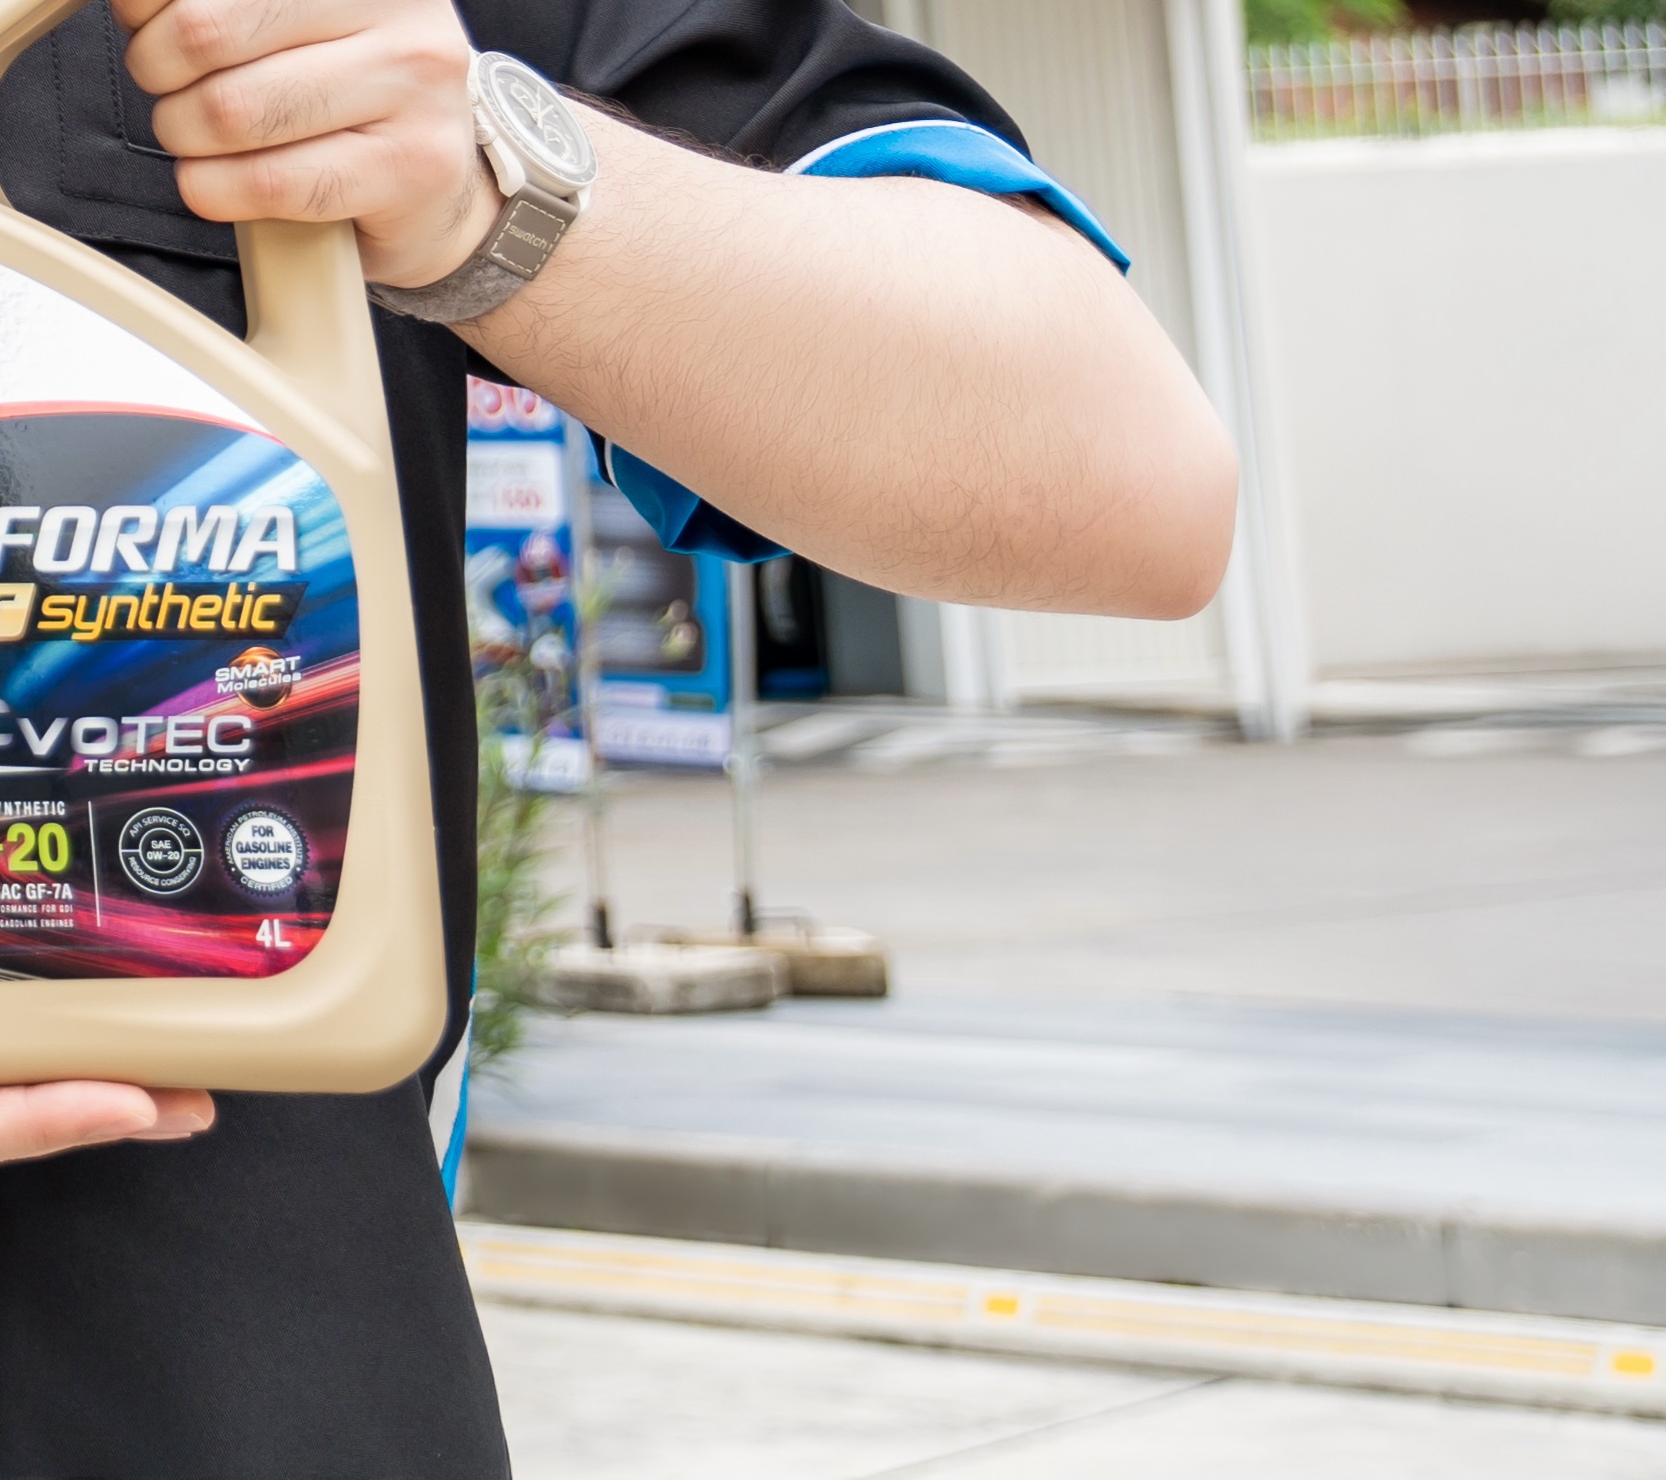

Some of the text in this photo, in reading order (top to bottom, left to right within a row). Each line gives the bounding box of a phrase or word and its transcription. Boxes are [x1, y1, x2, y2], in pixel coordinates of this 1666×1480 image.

[508, 225, 548, 250] swatch
[38, 582, 283, 641] synthetic
[215, 656, 301, 682] SMART
[217, 671, 302, 694] Molecules
[84, 758, 251, 774] TECHNOLOGY
[129, 823, 143, 837] API
[142, 815, 178, 827] SERVICE
[238, 811, 287, 826] PETROLEUM
[251, 826, 274, 837] FOR
[151, 840, 172, 849] SAE
[236, 841, 293, 854] GASOLINE
[128, 857, 160, 886] RESOURCE
[241, 858, 291, 870] ENGINES
[26, 882, 73, 899] GF-7A
[241, 875, 293, 891] CERTIFIED
[41, 904, 56, 913] FOR
[59, 904, 73, 913] GDI
[0, 919, 37, 928] GASOLINE
[255, 918, 292, 948] 4L
